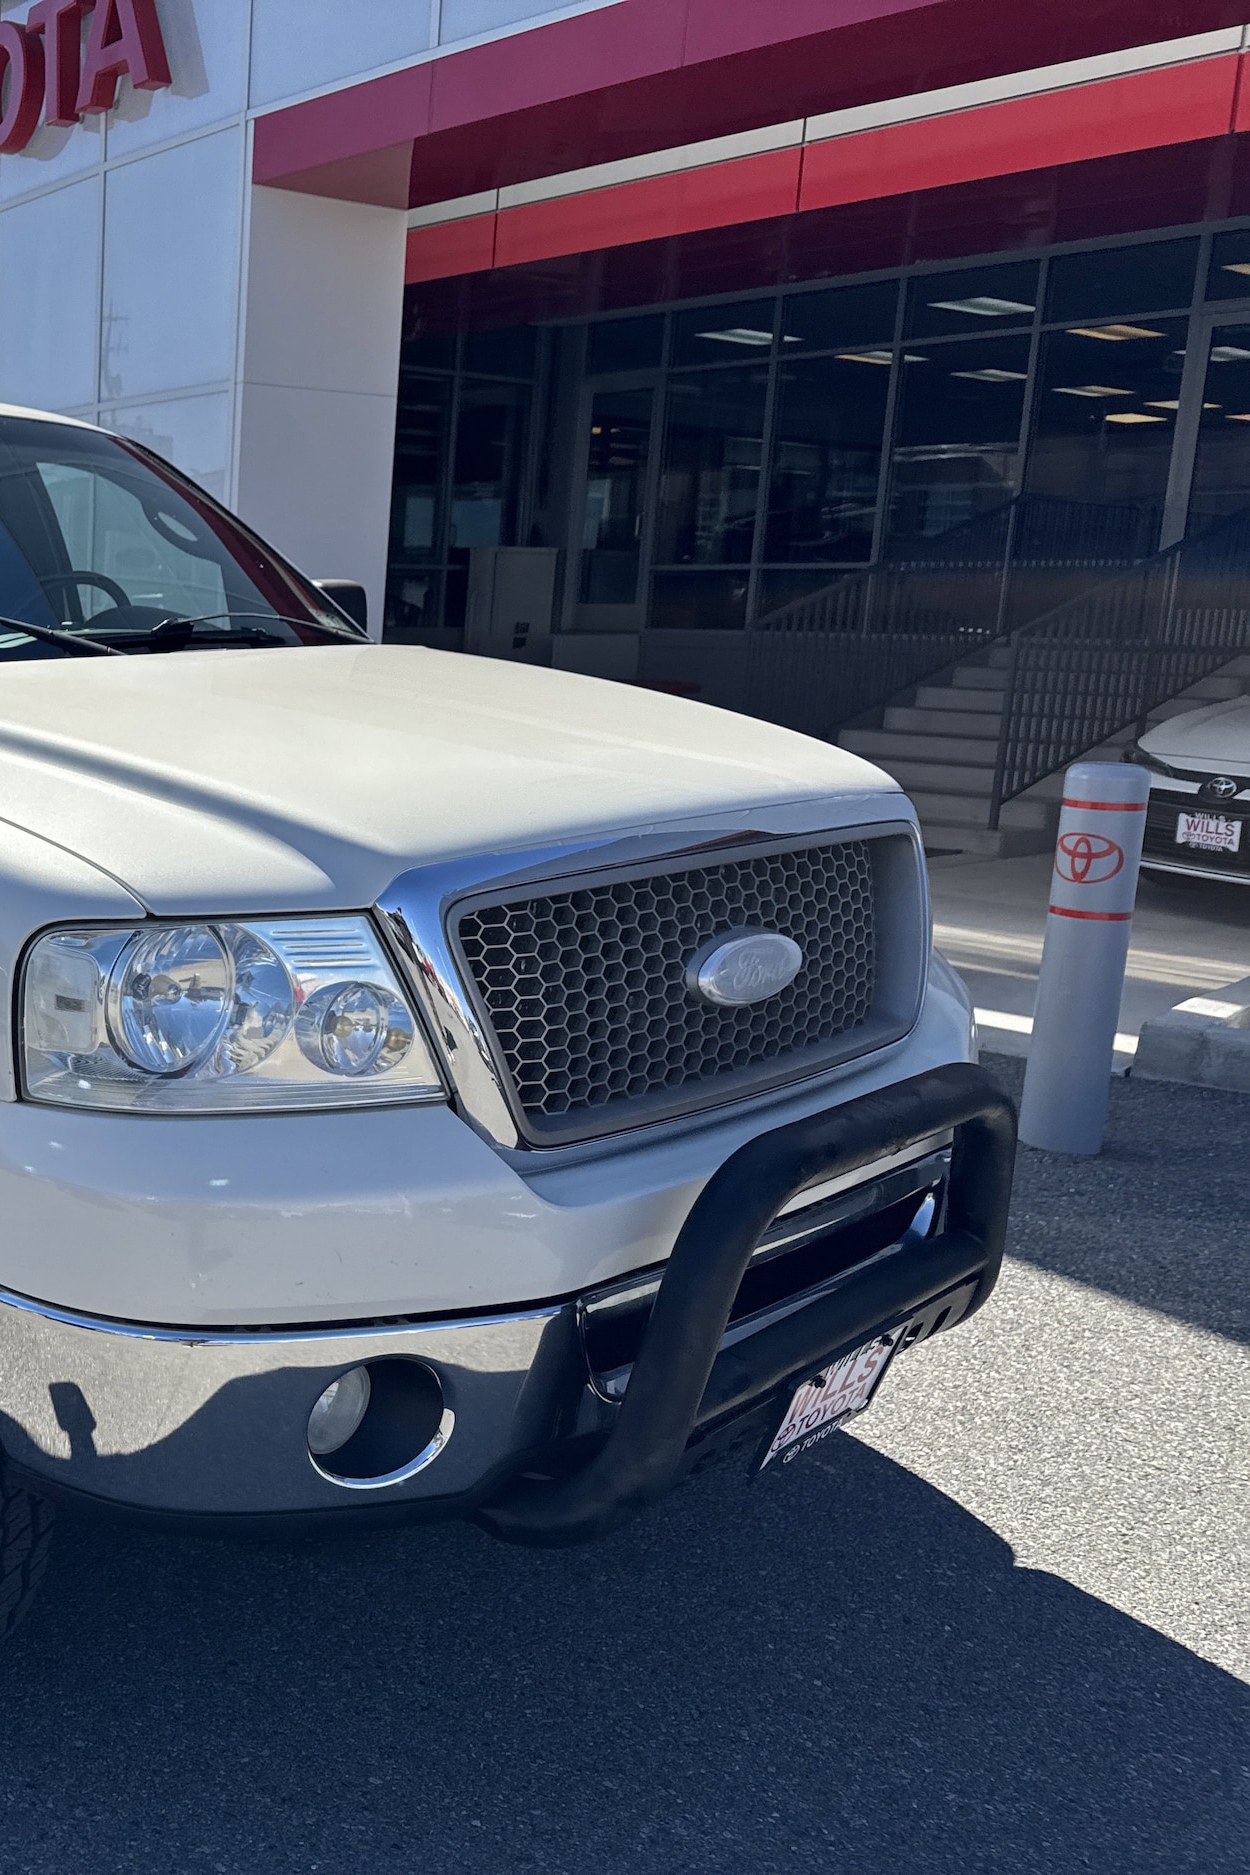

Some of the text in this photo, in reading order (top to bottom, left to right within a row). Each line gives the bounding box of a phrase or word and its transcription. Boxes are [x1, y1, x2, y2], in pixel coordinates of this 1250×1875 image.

[1186, 818, 1235, 837] WILLS
[1196, 833, 1235, 846] TOYOTA
[789, 1346, 884, 1423] WILLS
[795, 1383, 866, 1435] TOYOTA
[801, 1418, 843, 1451] TOYOTA
